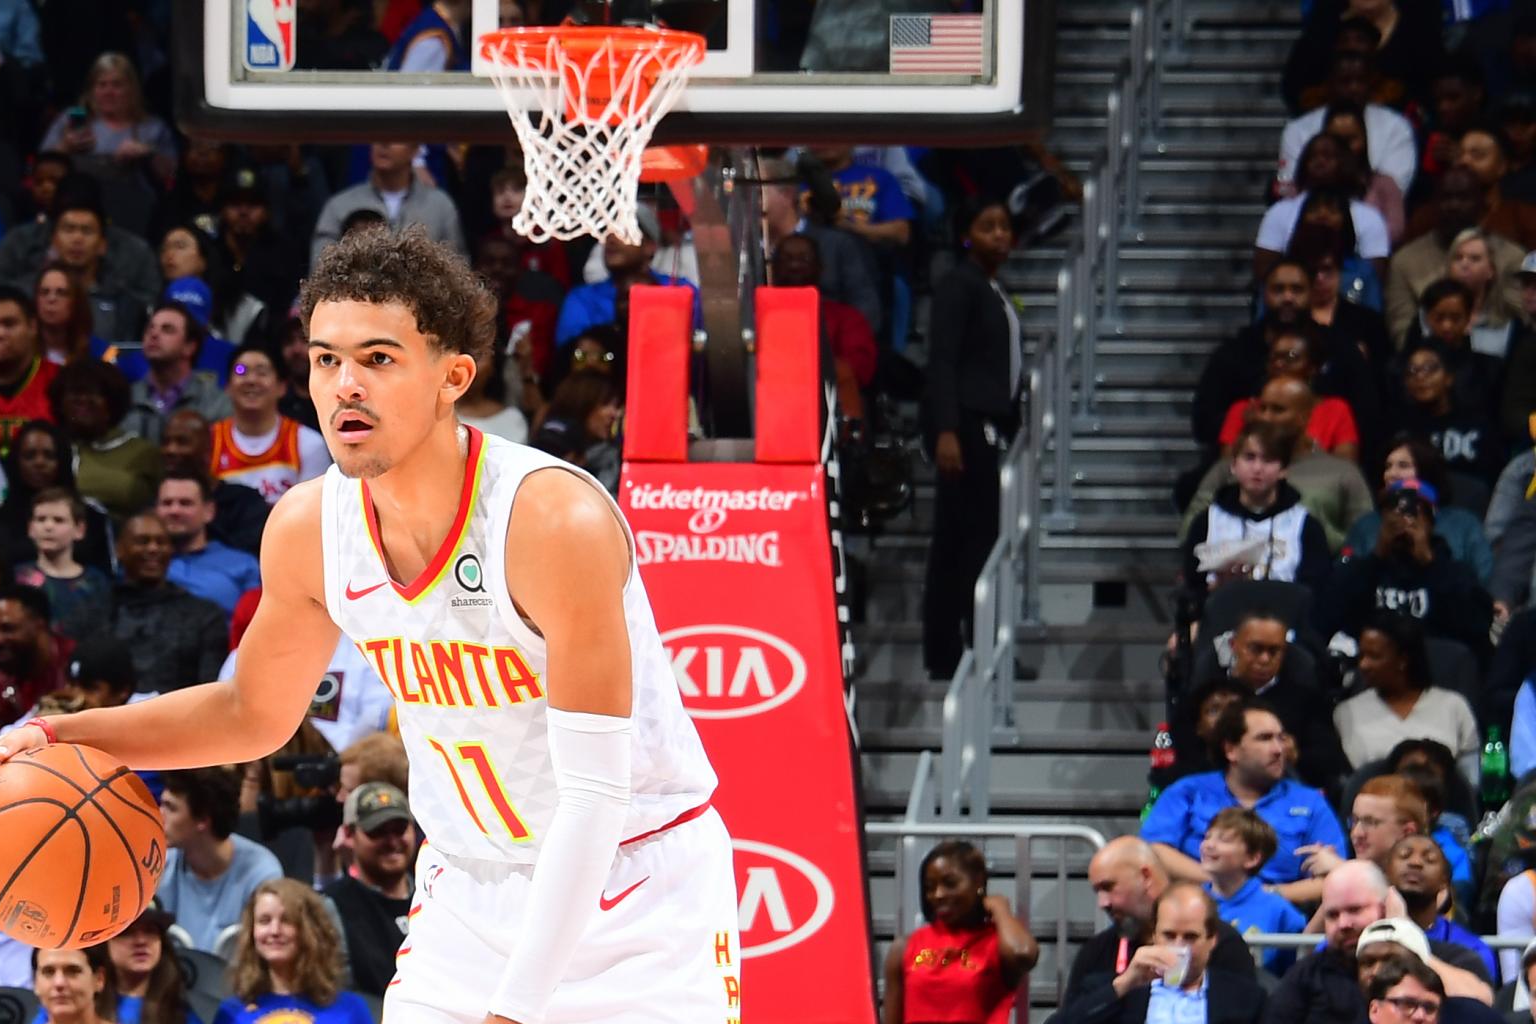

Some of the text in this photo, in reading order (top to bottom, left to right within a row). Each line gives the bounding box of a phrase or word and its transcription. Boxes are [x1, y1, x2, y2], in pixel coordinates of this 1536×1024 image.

[630, 483, 798, 512] ticketmaster
[636, 530, 781, 566] SPALDING
[450, 594, 494, 608] sharecare
[354, 635, 548, 708] TLANTA
[666, 646, 776, 698] KIA
[424, 735, 533, 843] 11
